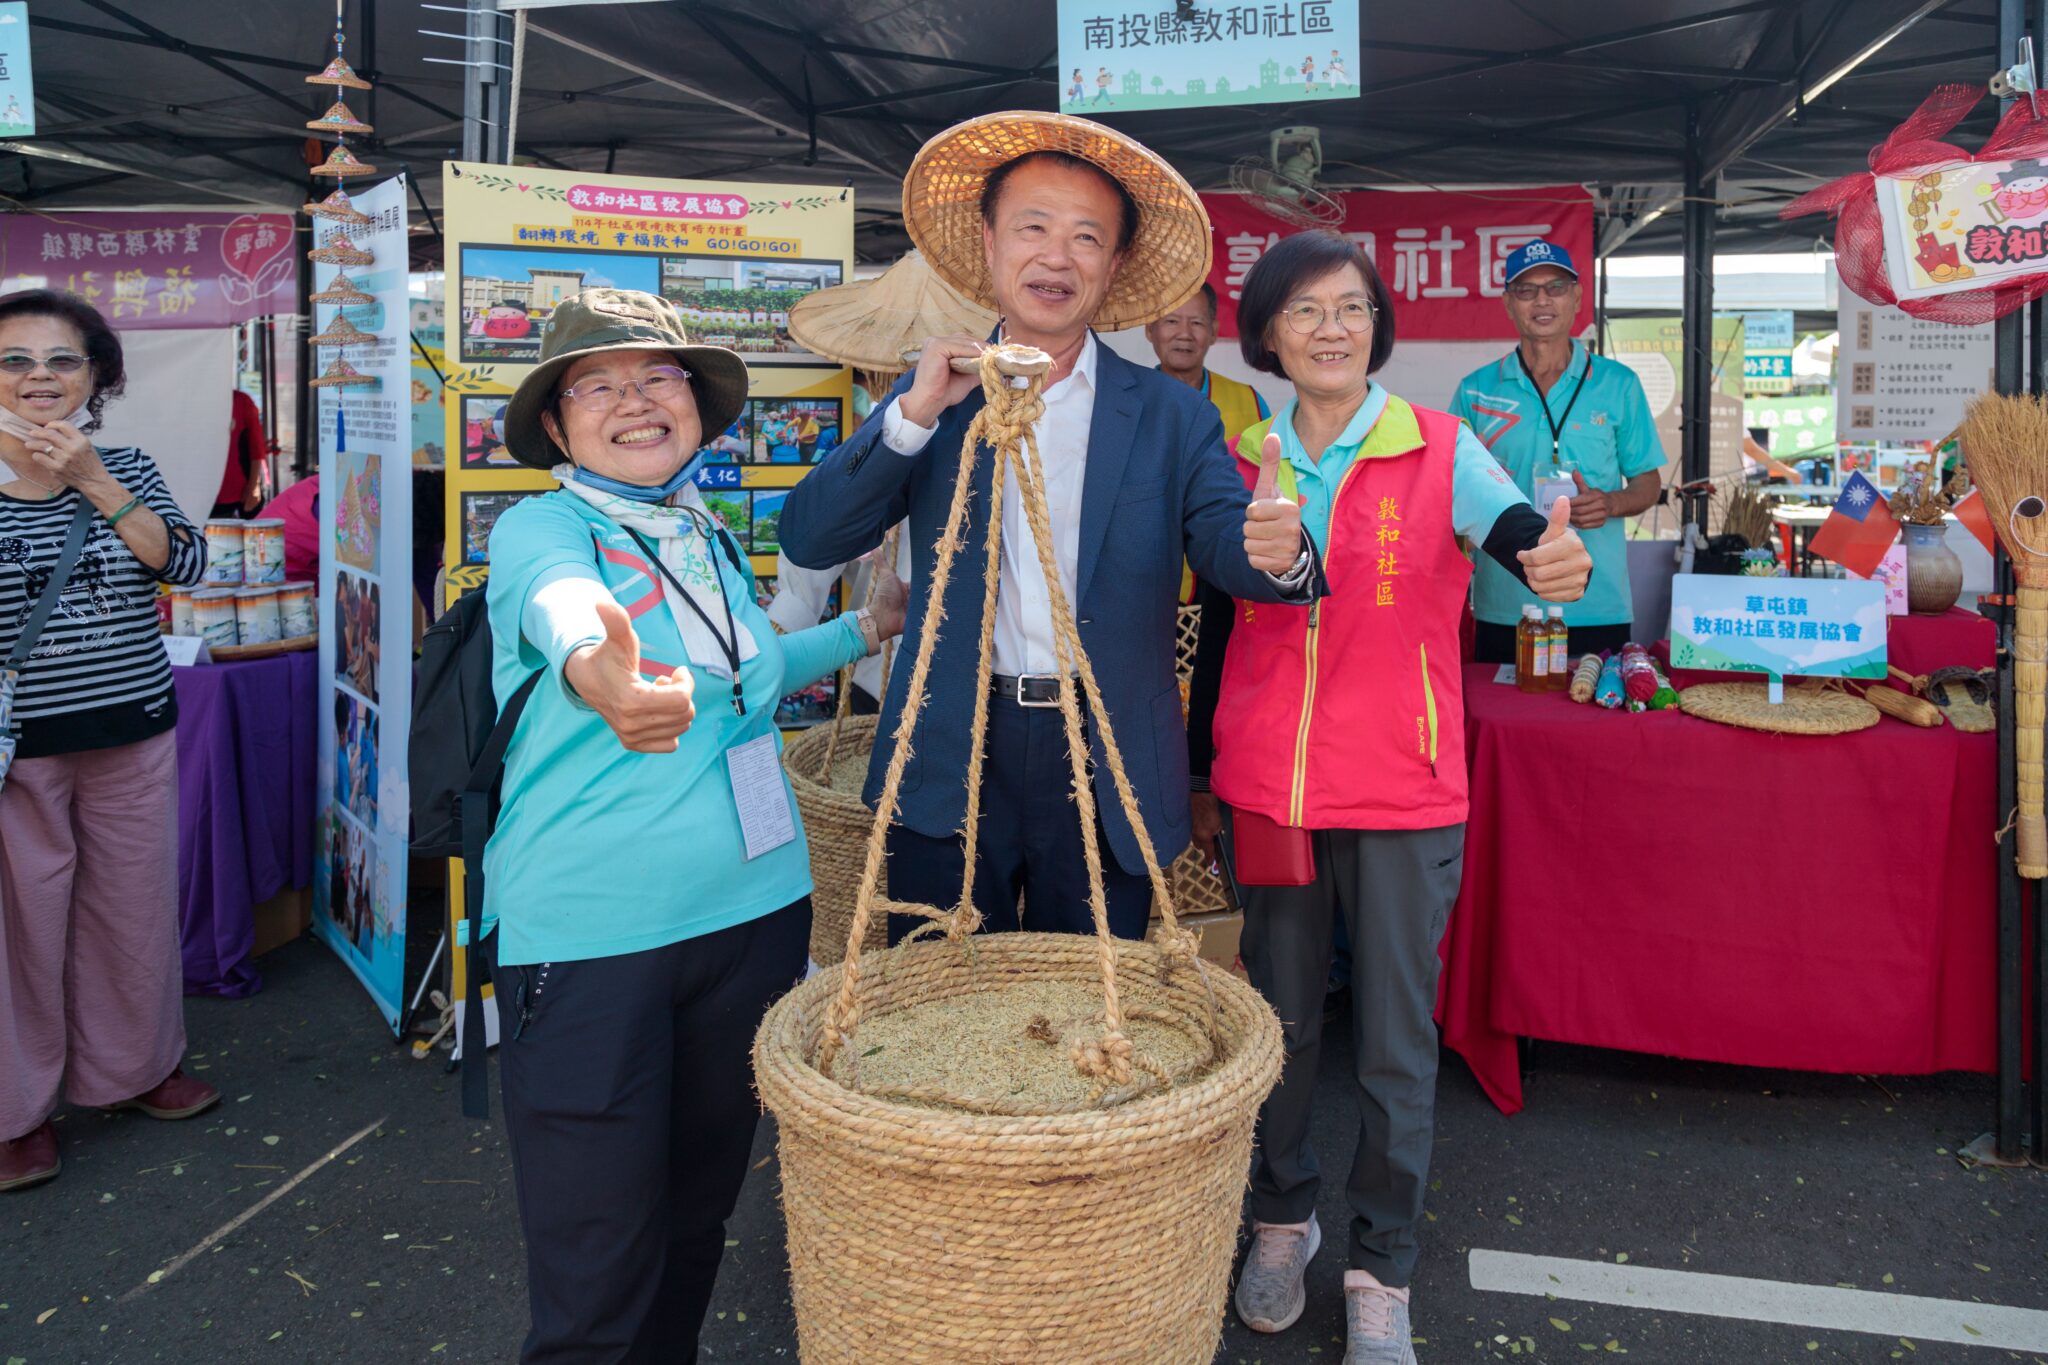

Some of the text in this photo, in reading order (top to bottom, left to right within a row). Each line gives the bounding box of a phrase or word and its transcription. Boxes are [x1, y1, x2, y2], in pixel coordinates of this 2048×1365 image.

[1083, 0, 1334, 50] 南投縣敦和社區
[571, 189, 745, 215] 敦和社區發展協會
[518, 227, 798, 253] 翻轉環境 幸福敦和 GO!GO!GO!
[1967, 224, 2048, 264] 敦和
[1225, 224, 1552, 301] 敦社區
[697, 467, 738, 485] 美化
[1376, 497, 1401, 606] 敦和社區
[1745, 595, 1809, 616] 草屯鎮
[1693, 616, 1862, 642] 敦和社區發展協會
